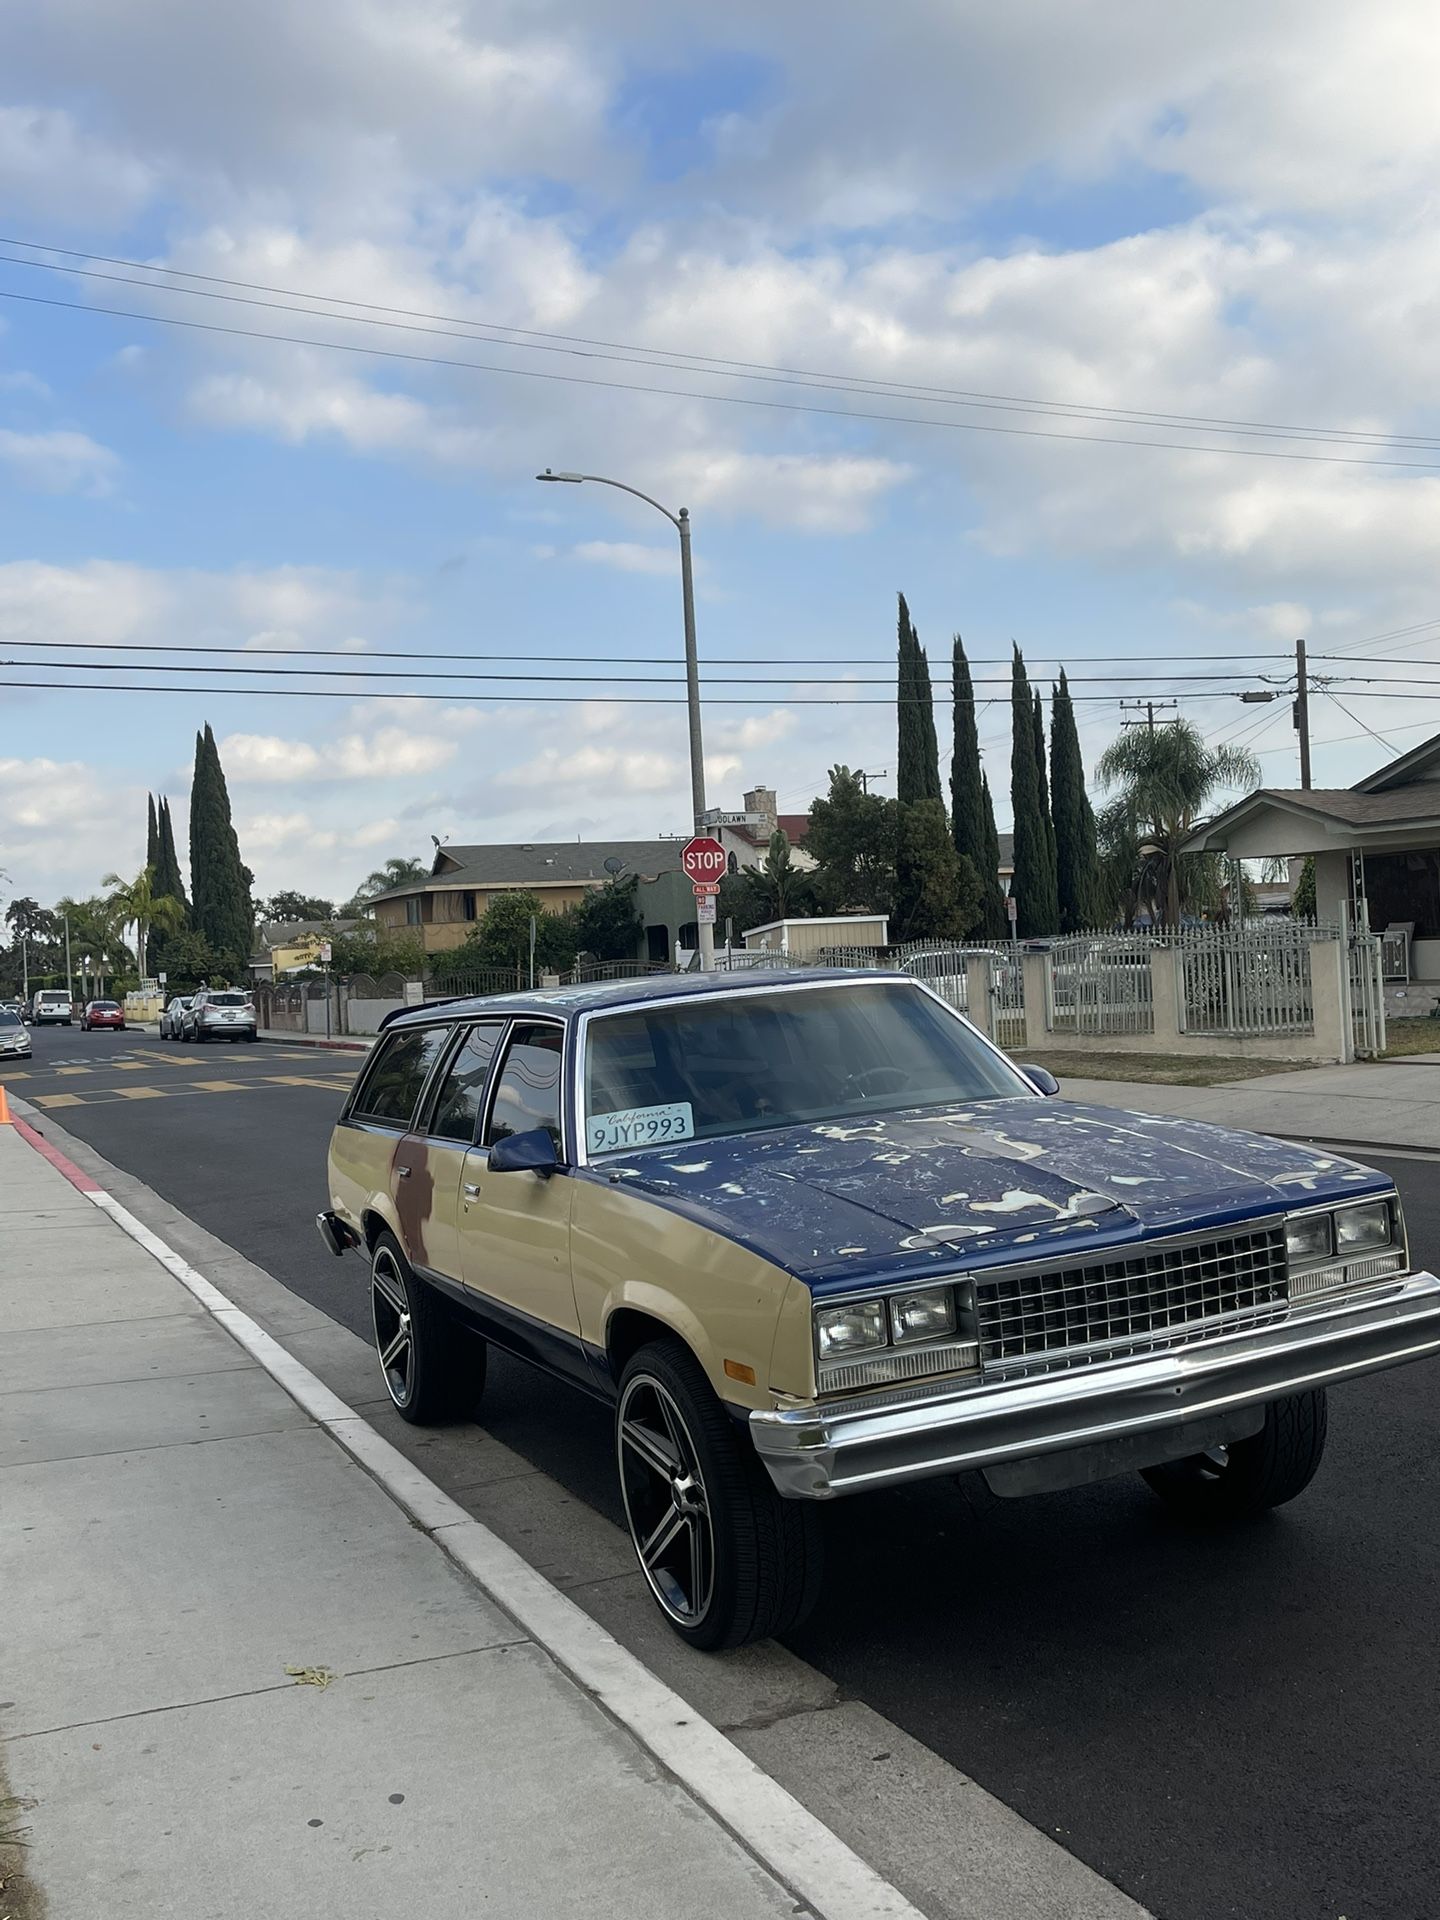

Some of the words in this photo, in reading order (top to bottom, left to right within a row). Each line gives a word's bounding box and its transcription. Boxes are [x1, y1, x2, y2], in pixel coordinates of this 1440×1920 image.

[687, 852, 723, 869] STOP
[608, 1110, 671, 1125] California
[594, 1117, 686, 1149] 9JYP993
